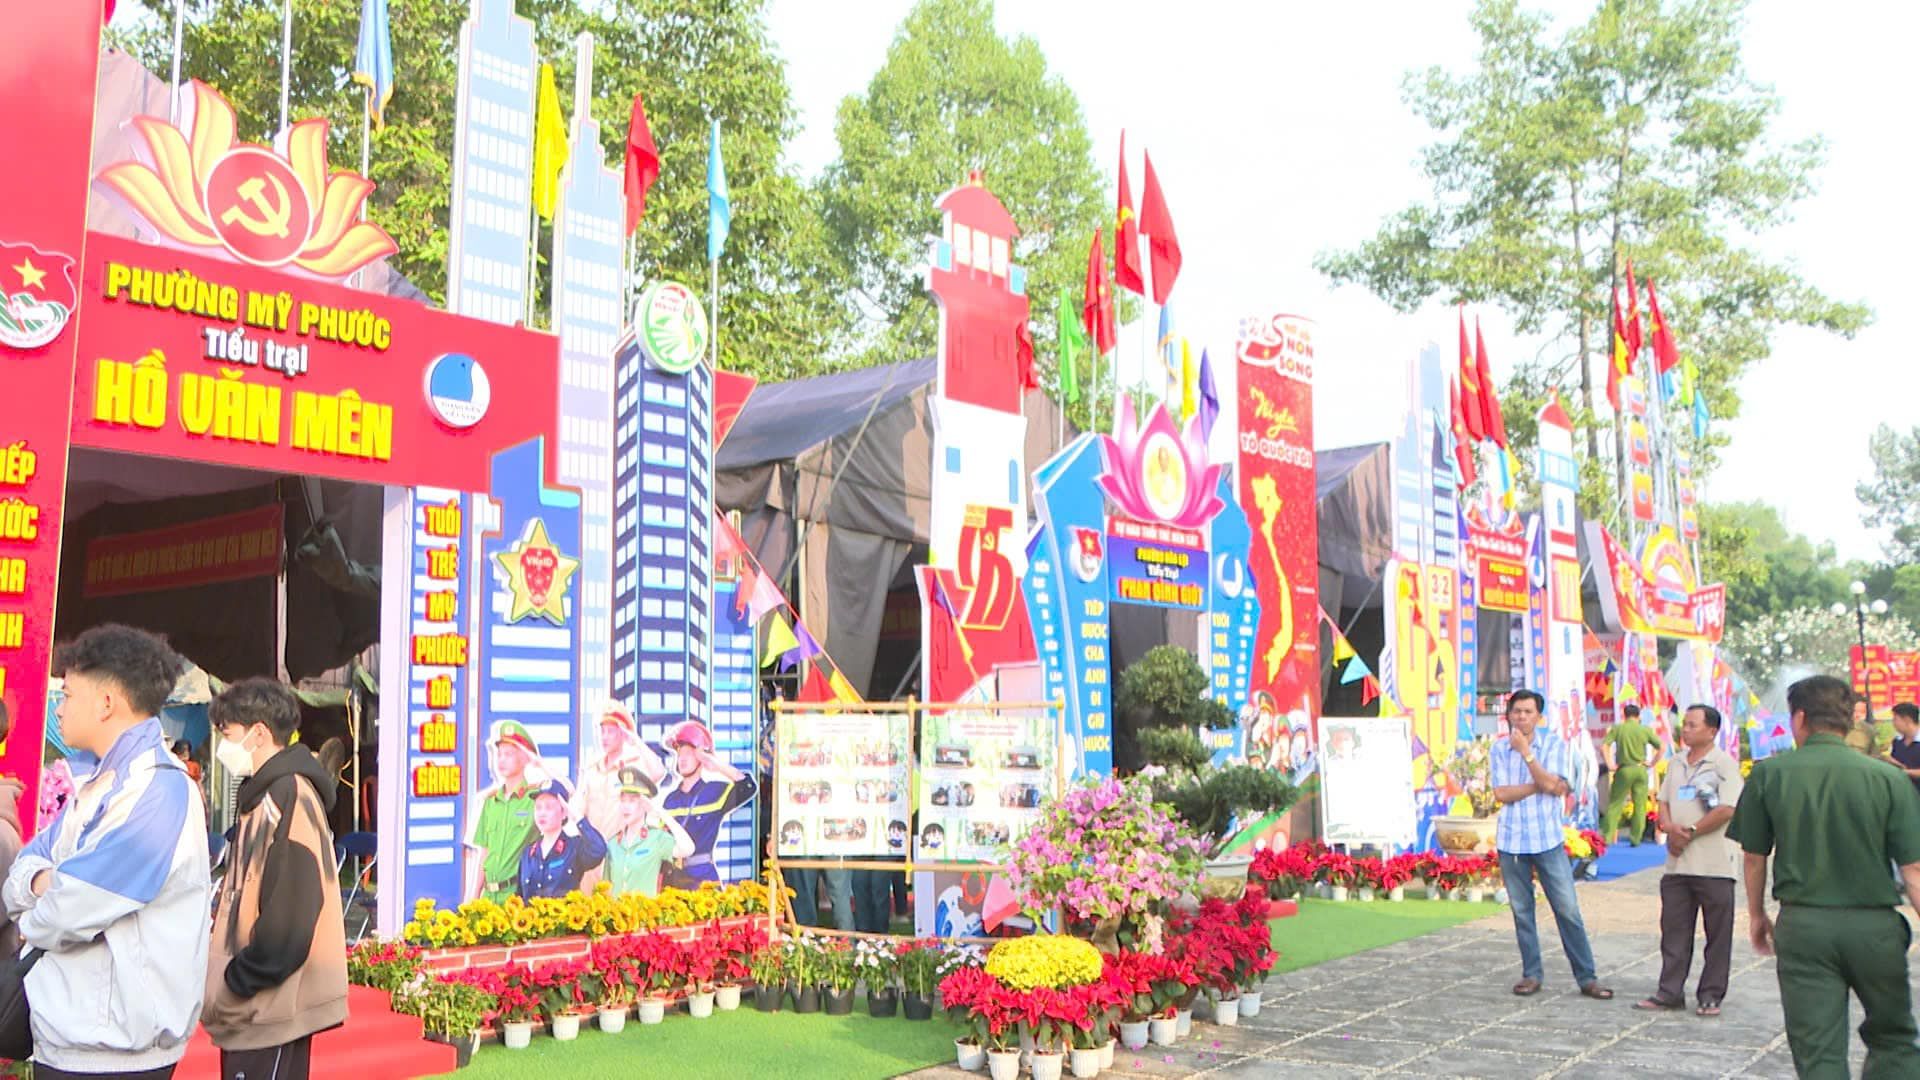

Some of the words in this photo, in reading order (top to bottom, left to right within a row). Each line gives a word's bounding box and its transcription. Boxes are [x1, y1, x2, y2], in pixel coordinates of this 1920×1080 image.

[104, 262, 239, 321] PHƯỜNG
[246, 290, 293, 330] MỸ
[297, 301, 392, 351] PHƯỚC
[203, 326, 258, 366] Tiểu
[264, 339, 308, 377] trại
[93, 348, 169, 429] HỒ
[178, 367, 282, 445] VĂN
[290, 388, 393, 461] MÊN
[0, 440, 37, 485] IẾP
[425, 498, 462, 537] TUỔI
[427, 543, 457, 579] TRẺ
[426, 589, 456, 622] MỸ
[1118, 577, 1151, 600] PHAN
[411, 633, 468, 666] PHƯỚC
[425, 674, 453, 709] ĐÃ
[1084, 668, 1106, 684] ANH
[413, 760, 462, 797] SÀNG
